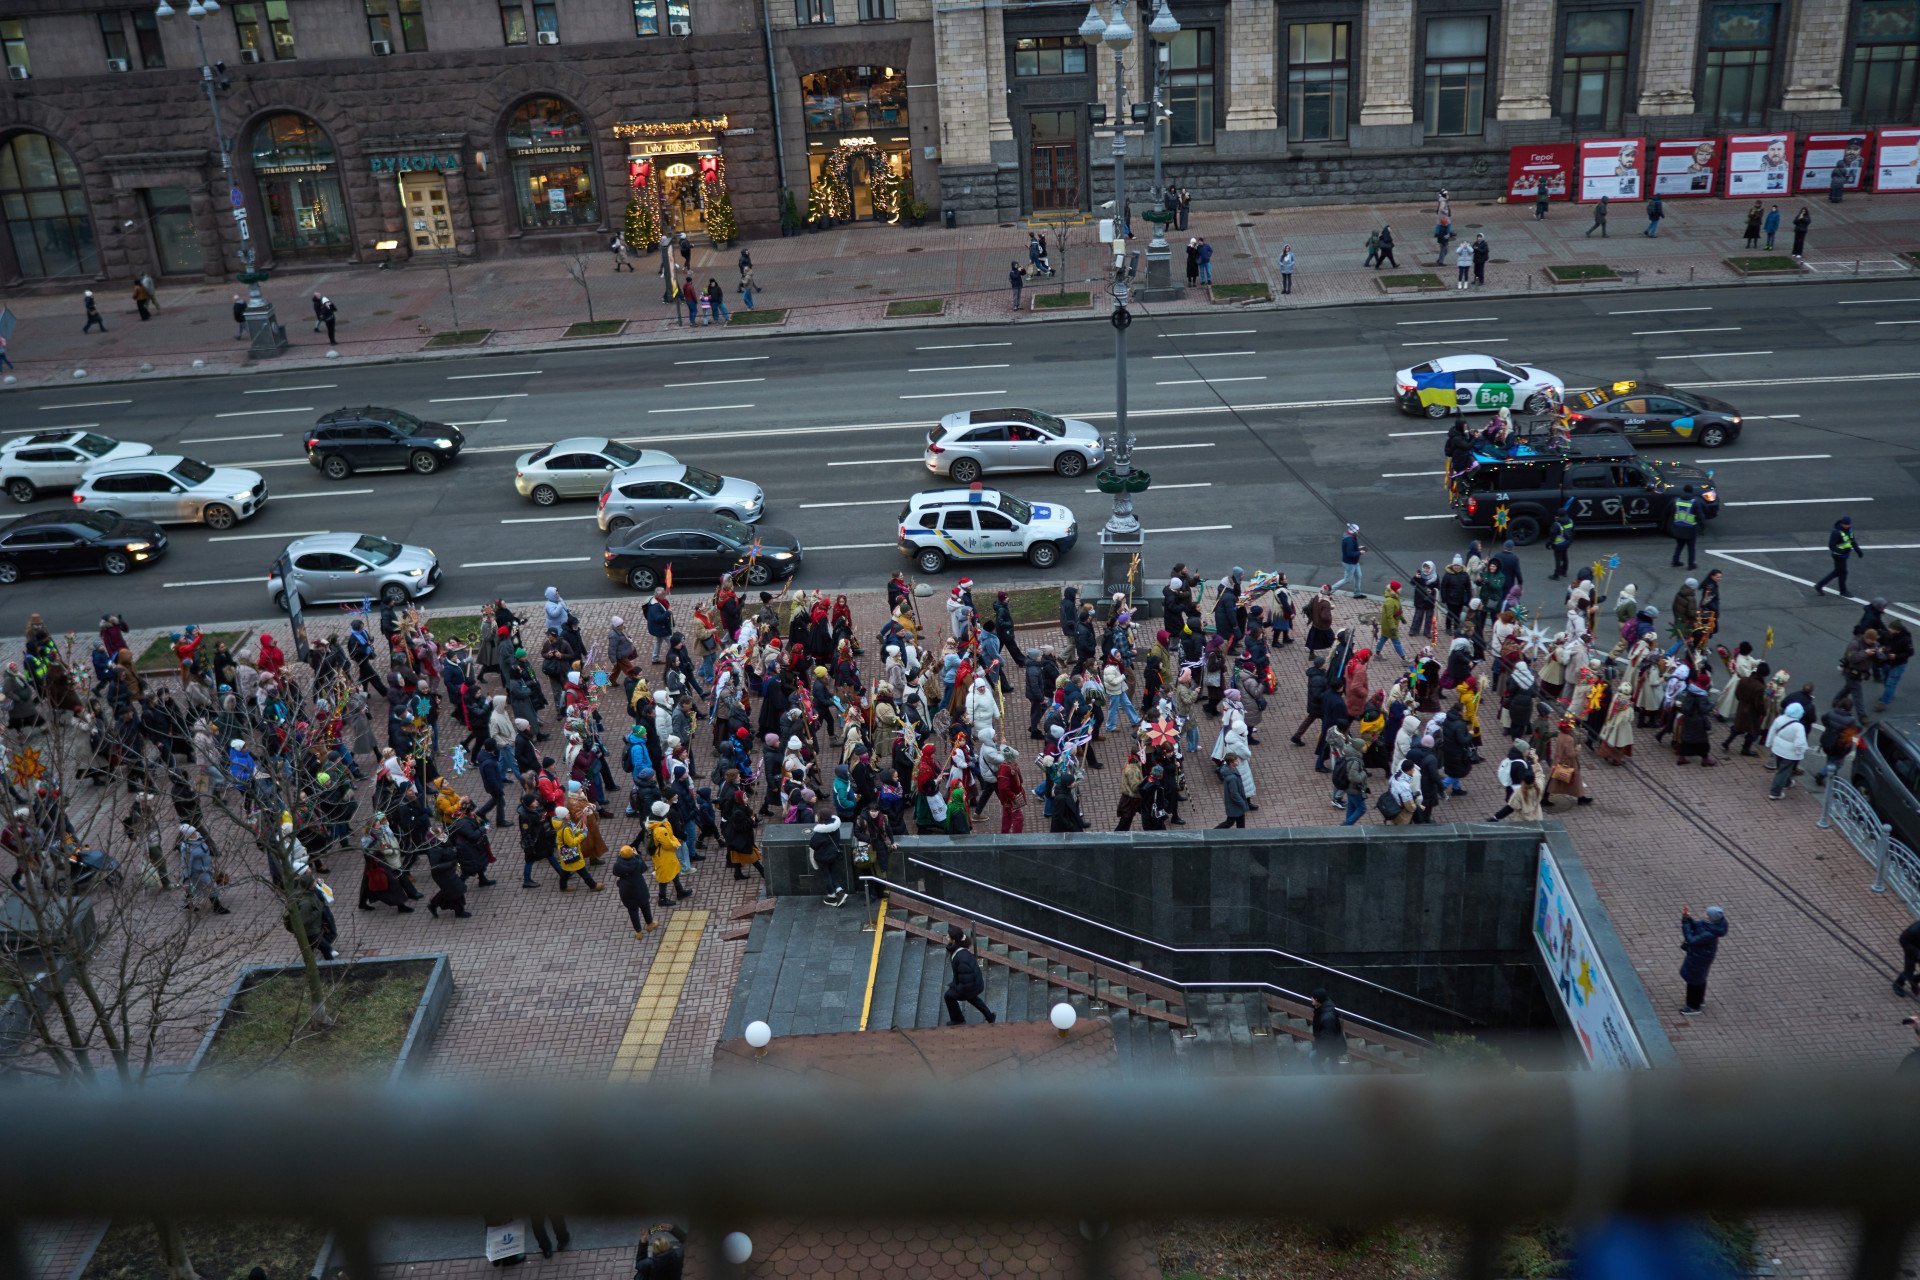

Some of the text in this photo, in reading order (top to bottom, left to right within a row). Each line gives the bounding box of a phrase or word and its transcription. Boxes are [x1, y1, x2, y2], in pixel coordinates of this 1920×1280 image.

[561, 144, 581, 154] кафе
[1531, 153, 1554, 162] Герої
[307, 164, 327, 172] кафе
[370, 153, 460, 174] РУКОЛА
[1481, 389, 1509, 405] Bolt
